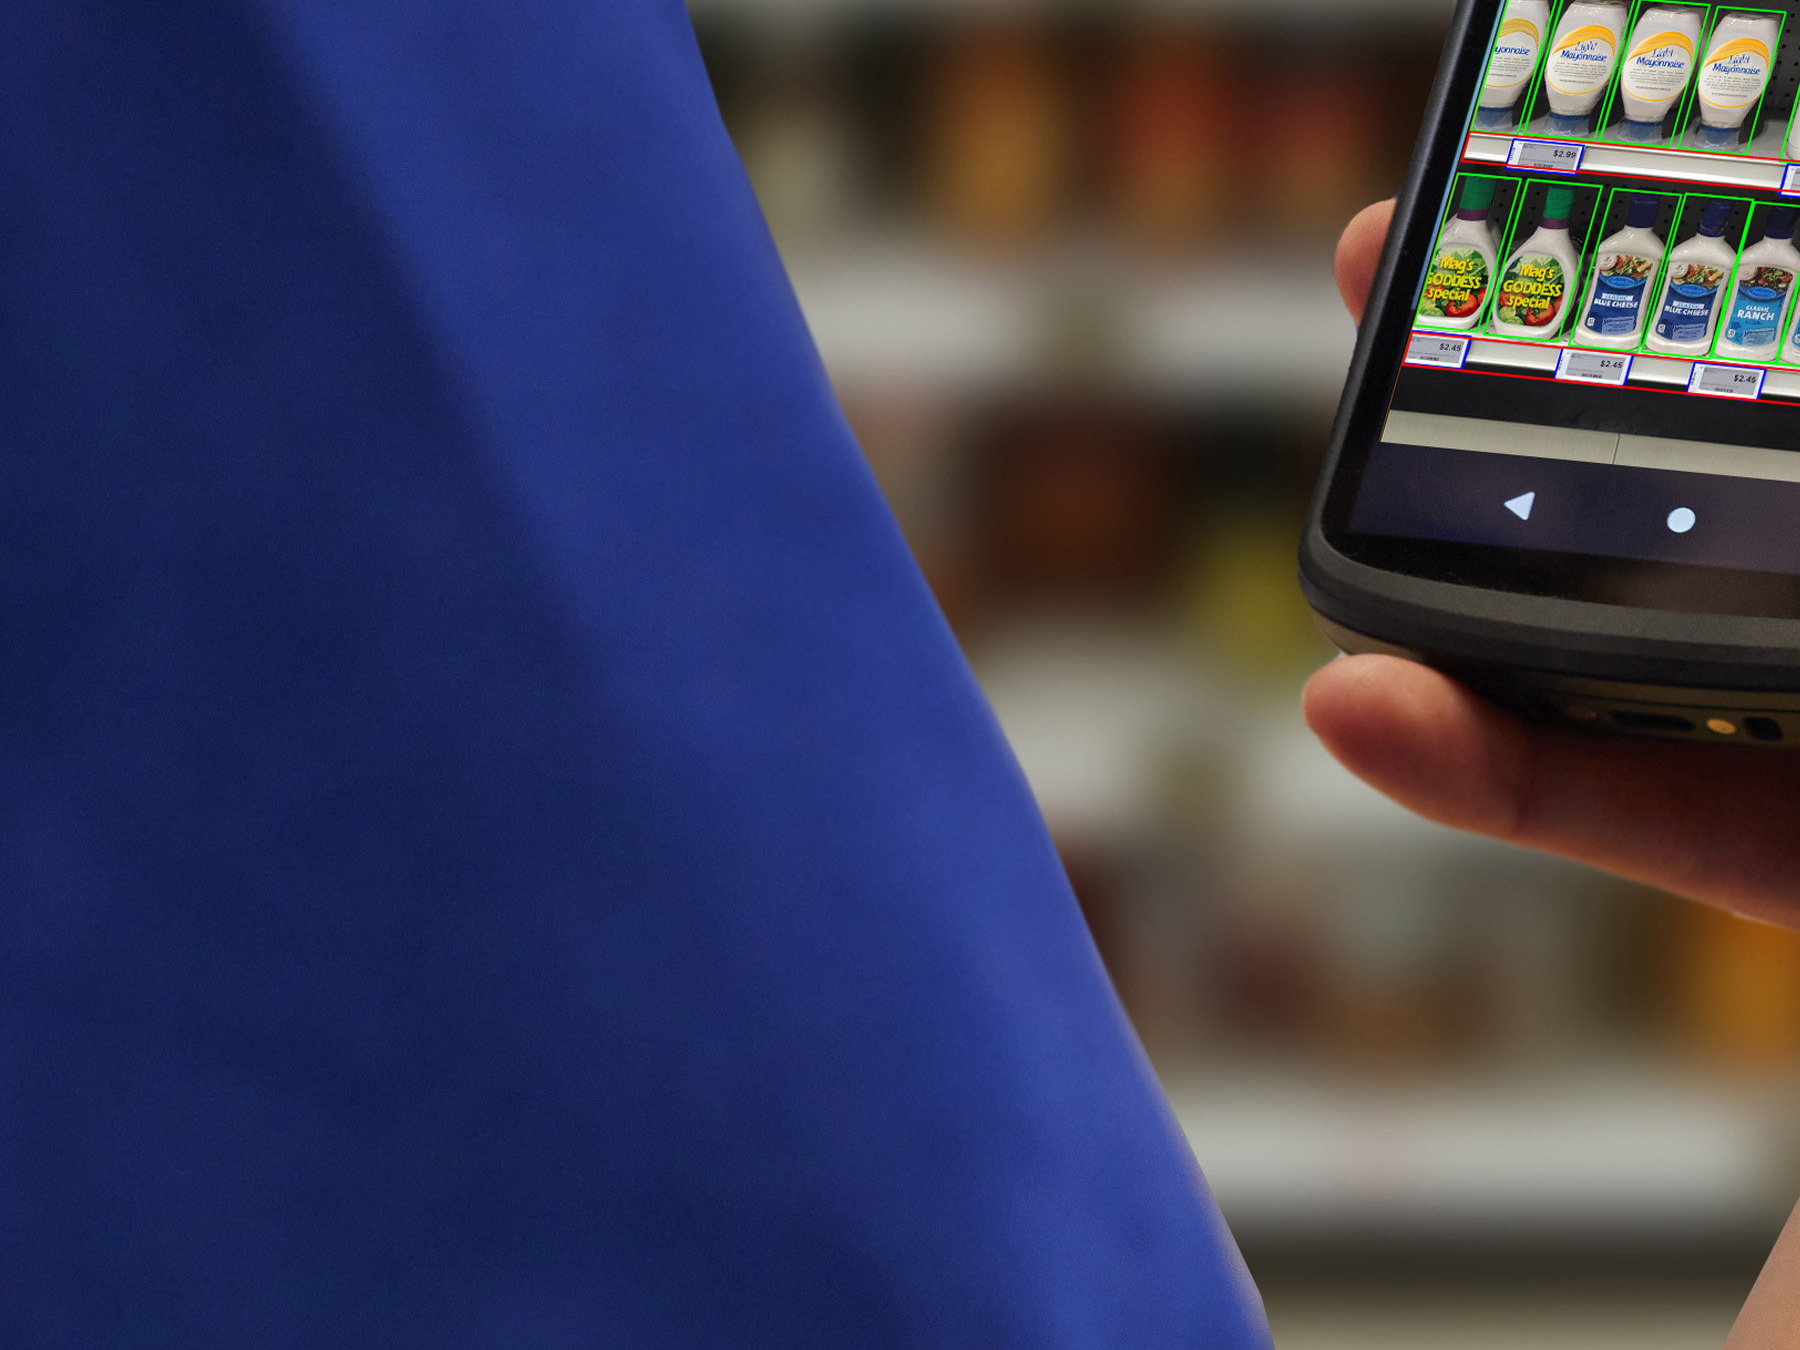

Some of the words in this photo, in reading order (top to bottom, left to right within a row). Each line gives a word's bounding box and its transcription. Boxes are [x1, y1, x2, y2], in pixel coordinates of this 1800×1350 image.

[1560, 50, 1607, 62] Mayonnaise
[1636, 56, 1685, 69] Mayonnaise
[1712, 63, 1761, 75] Mayonnaise
[1553, 150, 1577, 159] $2.99
[1440, 256, 1474, 274] Mag's
[1520, 263, 1555, 282] Mag's
[1503, 280, 1562, 297] GODDESS
[1428, 288, 1471, 302] special
[1507, 295, 1551, 309] special
[1594, 298, 1611, 307] BLUE
[1613, 300, 1638, 308] CHEESE
[1664, 305, 1682, 314] BLUE
[1683, 308, 1709, 316] CHEESE
[1737, 309, 1775, 321] RANCH
[1439, 342, 1462, 352] $2.45
[1601, 359, 1624, 369] $2.45
[1734, 374, 1756, 384] $2.45
